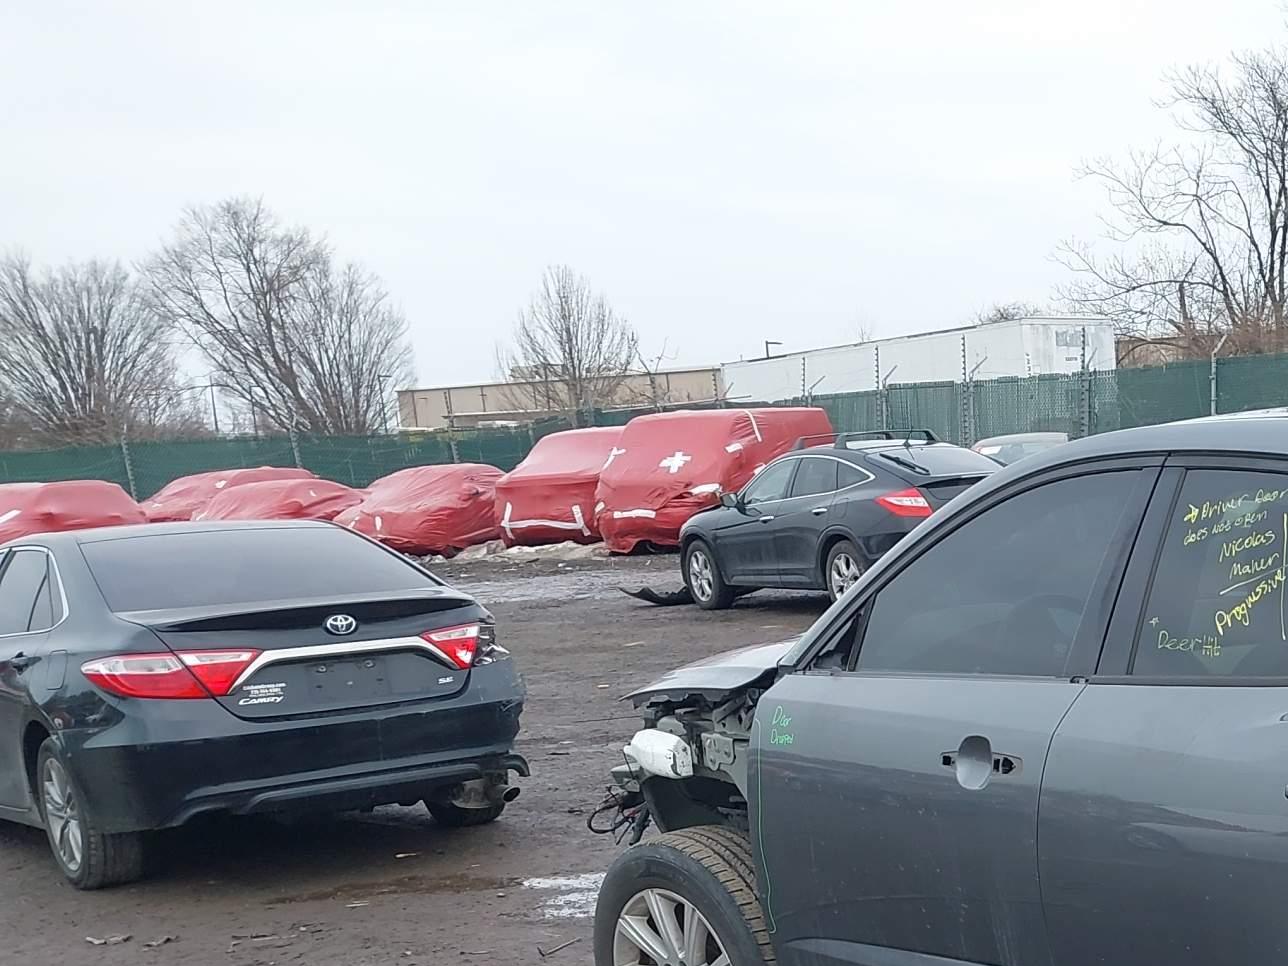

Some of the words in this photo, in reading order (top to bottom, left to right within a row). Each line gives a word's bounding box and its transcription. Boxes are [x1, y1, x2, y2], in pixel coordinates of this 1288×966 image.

[1201, 494, 1249, 520] Driver
[1184, 529, 1208, 545] does
[1219, 530, 1276, 562] Nicolas
[1158, 630, 1202, 652] Deer
